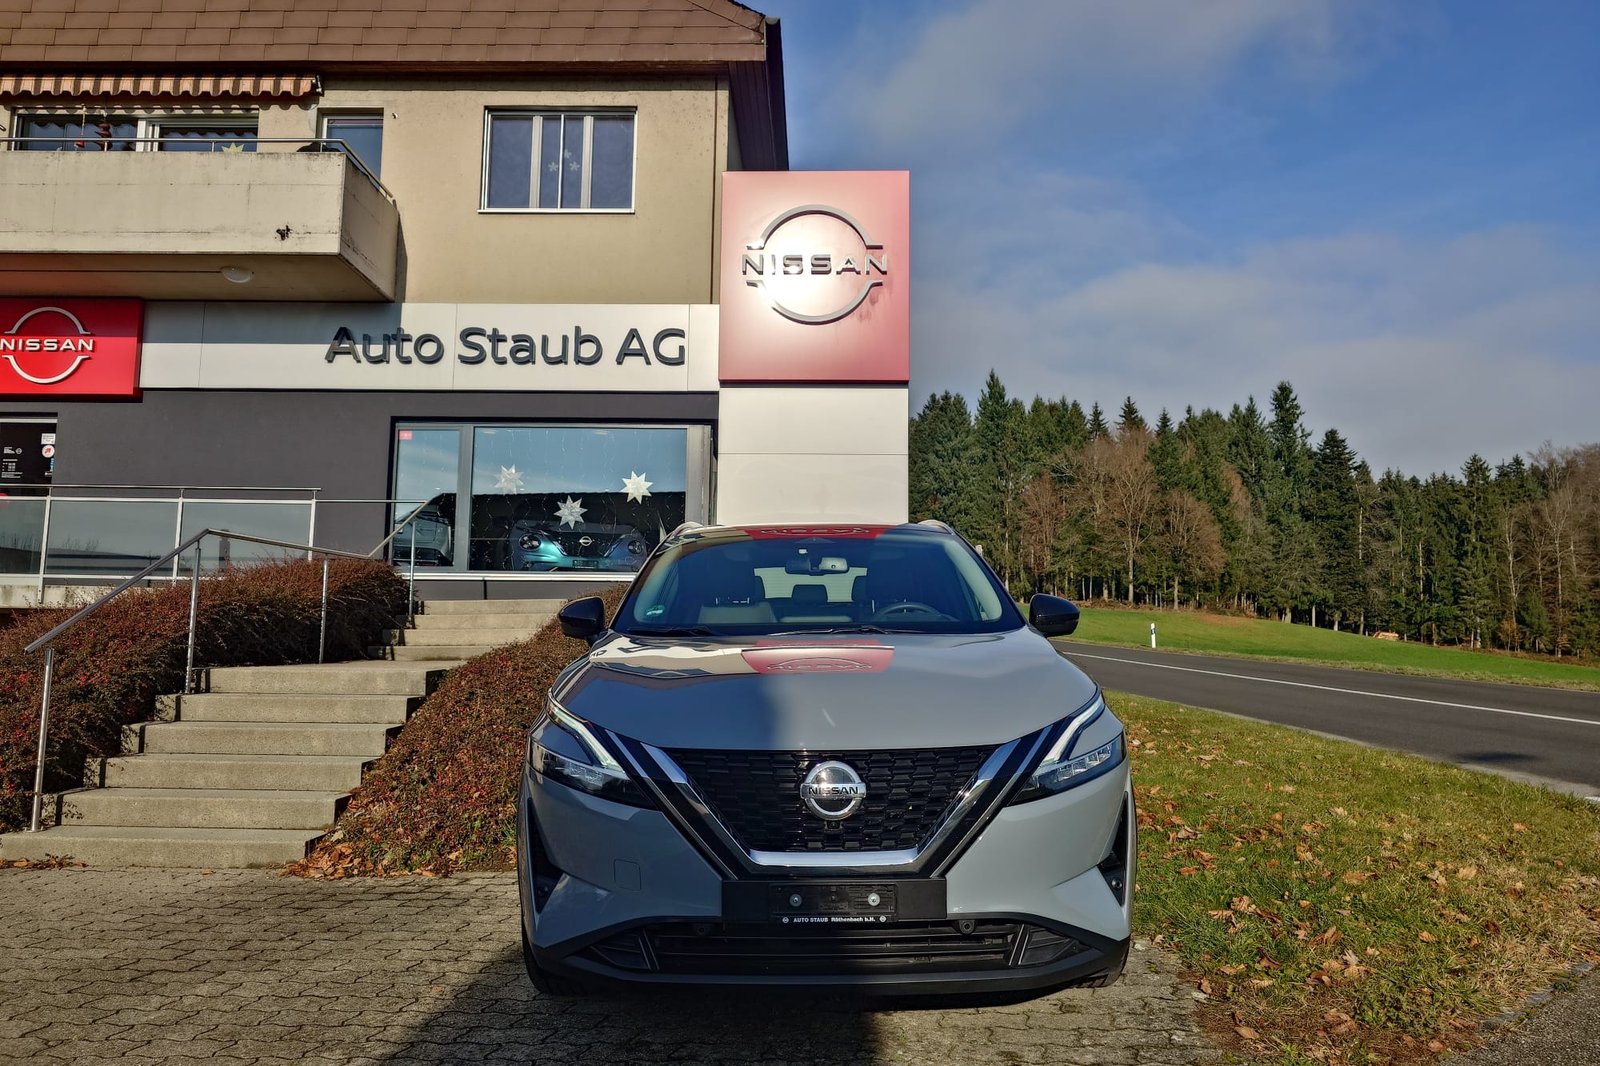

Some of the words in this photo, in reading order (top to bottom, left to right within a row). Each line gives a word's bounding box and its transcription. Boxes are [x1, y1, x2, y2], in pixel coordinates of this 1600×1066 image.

[742, 254, 888, 275] NISSAN
[0, 338, 94, 351] NISSAN
[325, 326, 445, 365] Auto
[457, 326, 604, 366] Staub
[615, 328, 686, 366] AG
[808, 786, 858, 795] NISSAN
